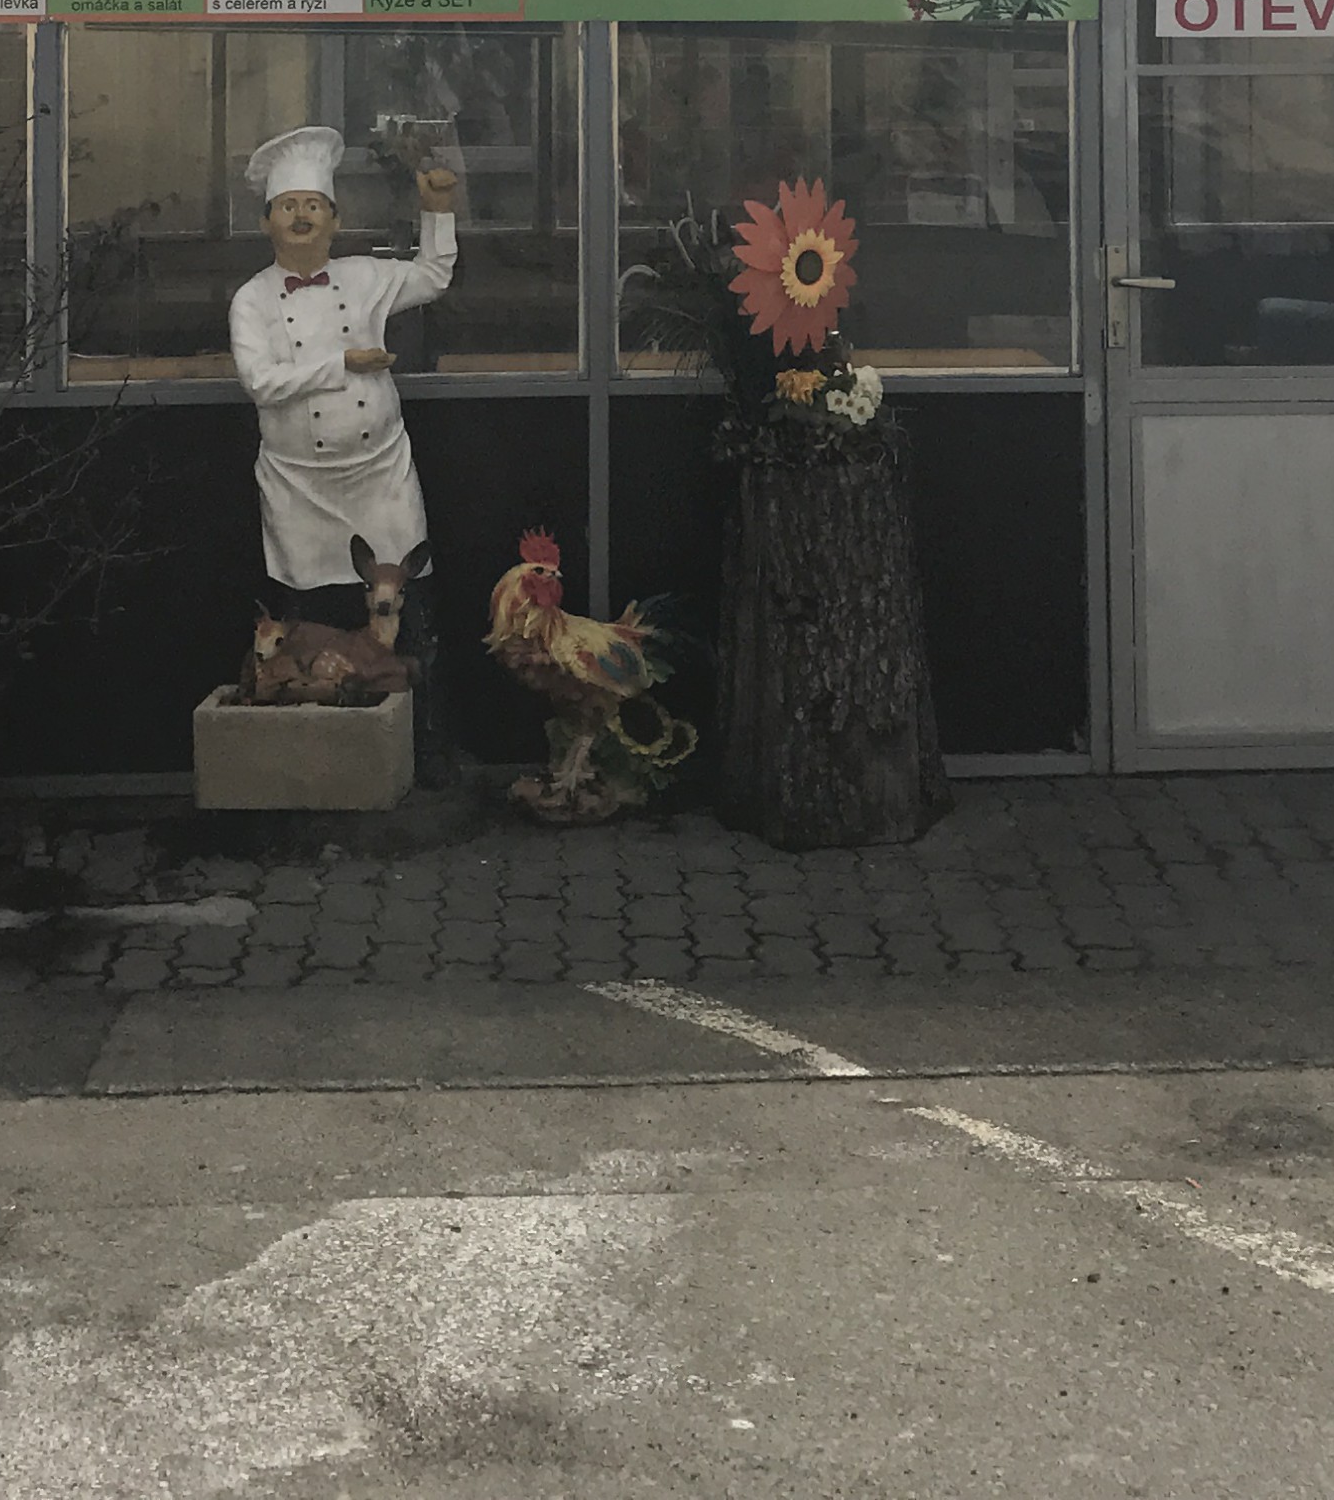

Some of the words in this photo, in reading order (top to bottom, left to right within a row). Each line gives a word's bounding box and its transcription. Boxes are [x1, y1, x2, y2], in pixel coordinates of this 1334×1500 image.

[134, 0, 144, 11] a
[212, 0, 220, 10] s
[287, 0, 296, 10] a
